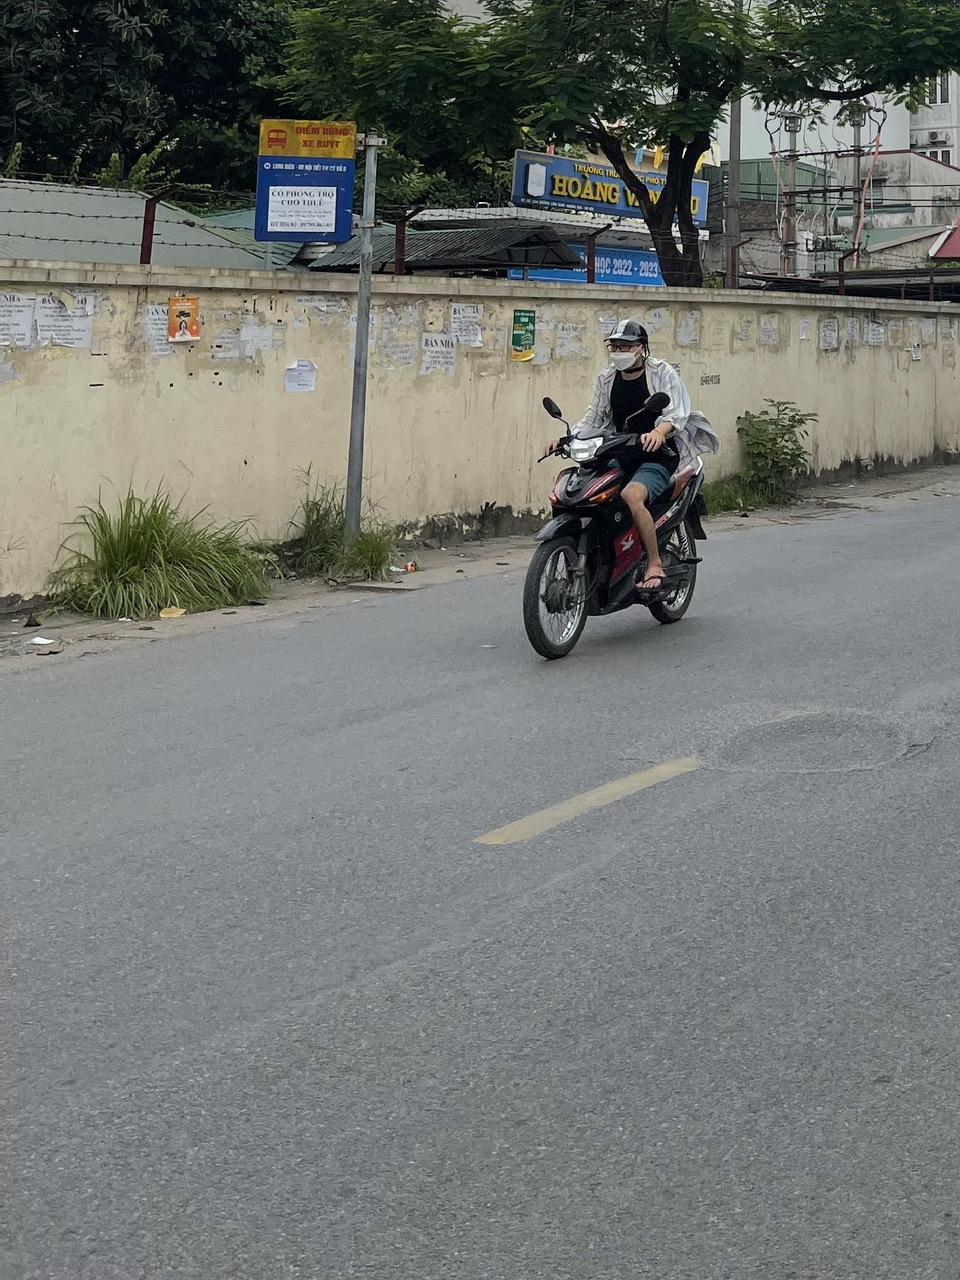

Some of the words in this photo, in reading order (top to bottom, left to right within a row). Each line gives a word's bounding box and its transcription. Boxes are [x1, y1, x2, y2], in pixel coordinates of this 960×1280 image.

[302, 140, 314, 148] XE
[553, 173, 619, 204] HOÀNG
[595, 257, 611, 277] HỌC
[612, 259, 632, 276] 2022
[640, 261, 658, 278] 2023
